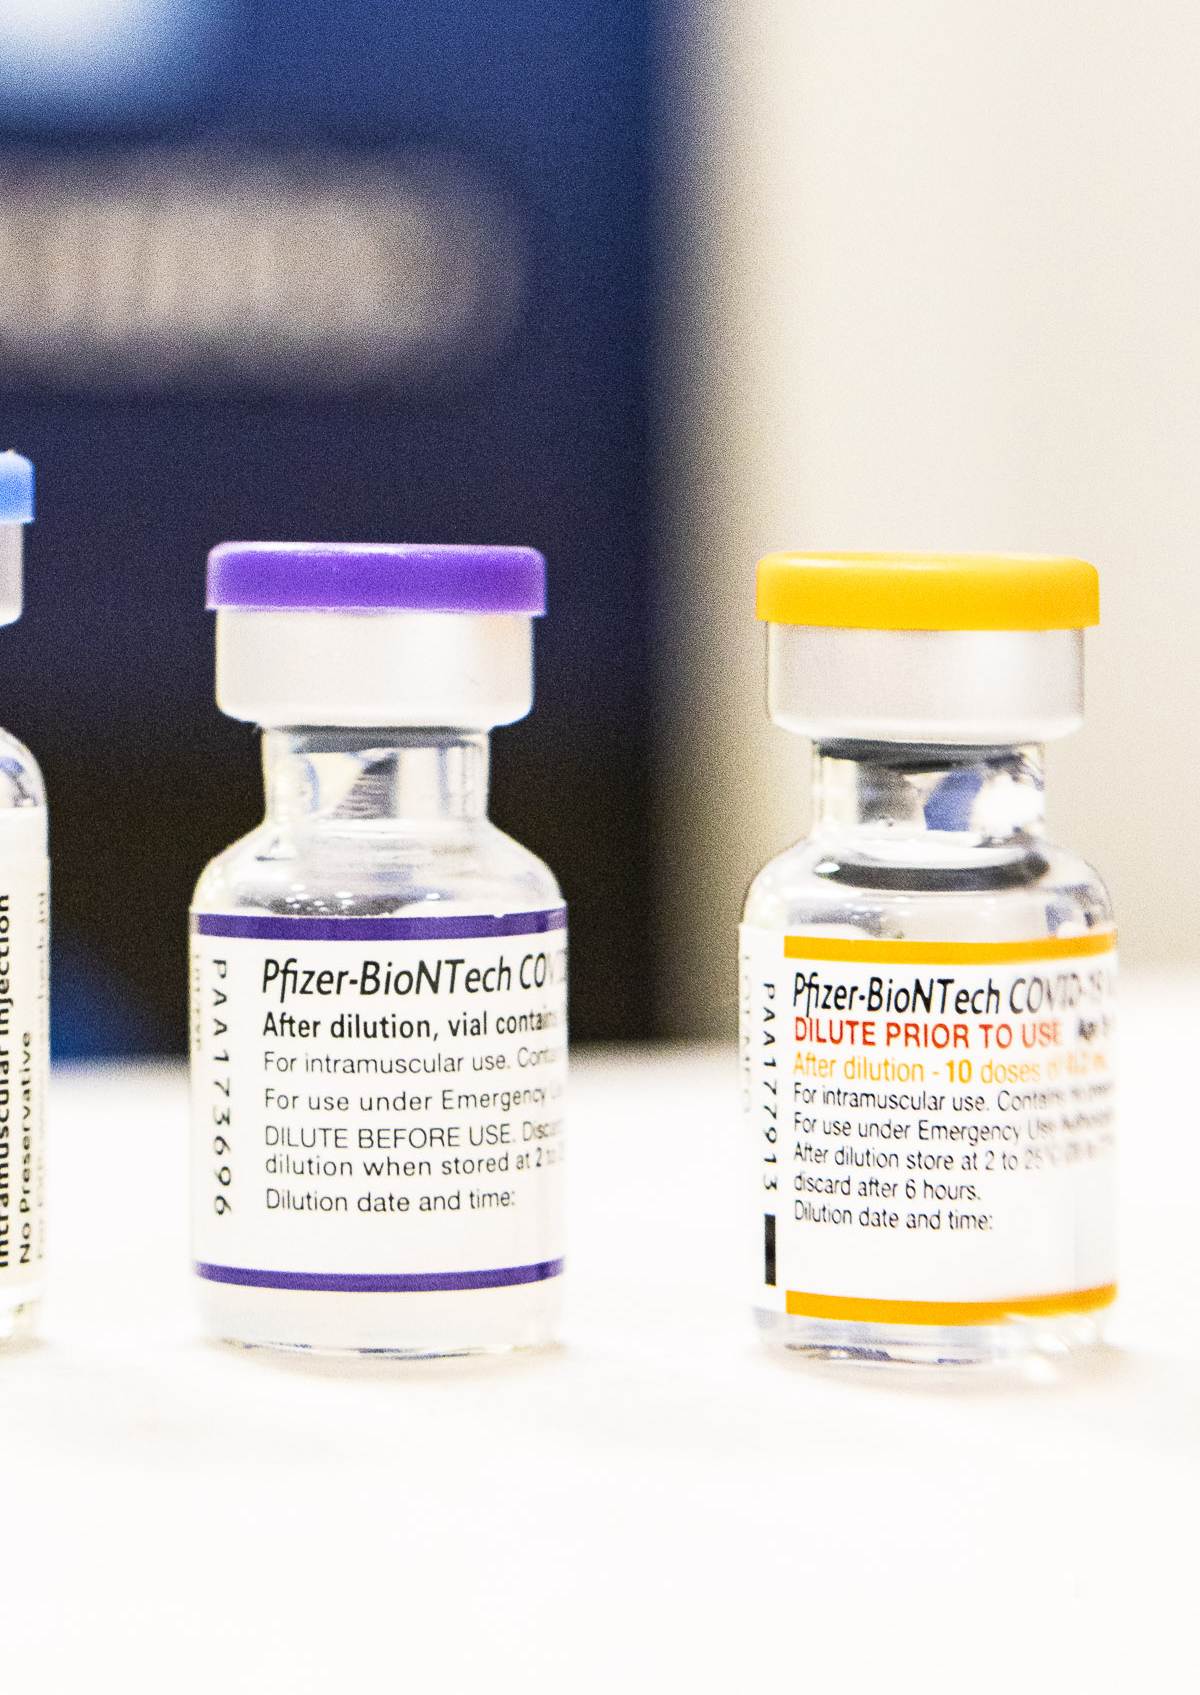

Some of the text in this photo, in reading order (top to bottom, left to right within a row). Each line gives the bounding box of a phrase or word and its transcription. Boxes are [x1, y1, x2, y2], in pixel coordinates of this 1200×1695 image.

[262, 956, 511, 1002] Pfizer-BioNTech
[793, 972, 1000, 1017] Pfizer-BioNTech
[263, 1011, 320, 1038] After
[331, 1013, 438, 1041] dilution,
[449, 1011, 488, 1037] vial
[795, 1017, 876, 1046] DILUTE
[886, 1022, 969, 1049] PRIOR
[979, 1024, 1012, 1049] TO
[1022, 1021, 1064, 1048] USE
[264, 1052, 296, 1072] For
[306, 1052, 464, 1074] intramuscular
[472, 1052, 510, 1072] use.
[793, 1052, 836, 1079] After
[844, 1056, 924, 1083] dilution
[946, 1059, 972, 1084] 10
[981, 1059, 1041, 1084] doses
[265, 1088, 299, 1109] For
[309, 1094, 349, 1111] use
[360, 1091, 432, 1111] under
[442, 1088, 546, 1111] Emergency
[794, 1083, 817, 1104] For
[823, 1086, 945, 1112] intramuscular
[952, 1092, 990, 1112] use.
[265, 1126, 348, 1149] DILUTE
[358, 1128, 460, 1149] BEFORE
[470, 1125, 515, 1146] USE.
[794, 1112, 817, 1134] For
[822, 1119, 852, 1137] use
[858, 1118, 910, 1141] under
[919, 1119, 1021, 1146] Emergency
[20, 1031, 31, 1264] No Preservative
[794, 1141, 828, 1165] After
[835, 1145, 899, 1169] dilution
[906, 1150, 954, 1170] store
[961, 1152, 977, 1171] at
[985, 1150, 994, 1171] 2
[1002, 1151, 1018, 1171] to
[266, 1154, 352, 1176] dilution
[363, 1159, 432, 1176] when
[442, 1152, 508, 1176] stored
[516, 1151, 530, 1170] at
[267, 1188, 516, 1212] Dilution date and time:
[794, 1172, 980, 1201] discard after 6 hours.
[795, 1200, 993, 1230] Dilution date and time:
